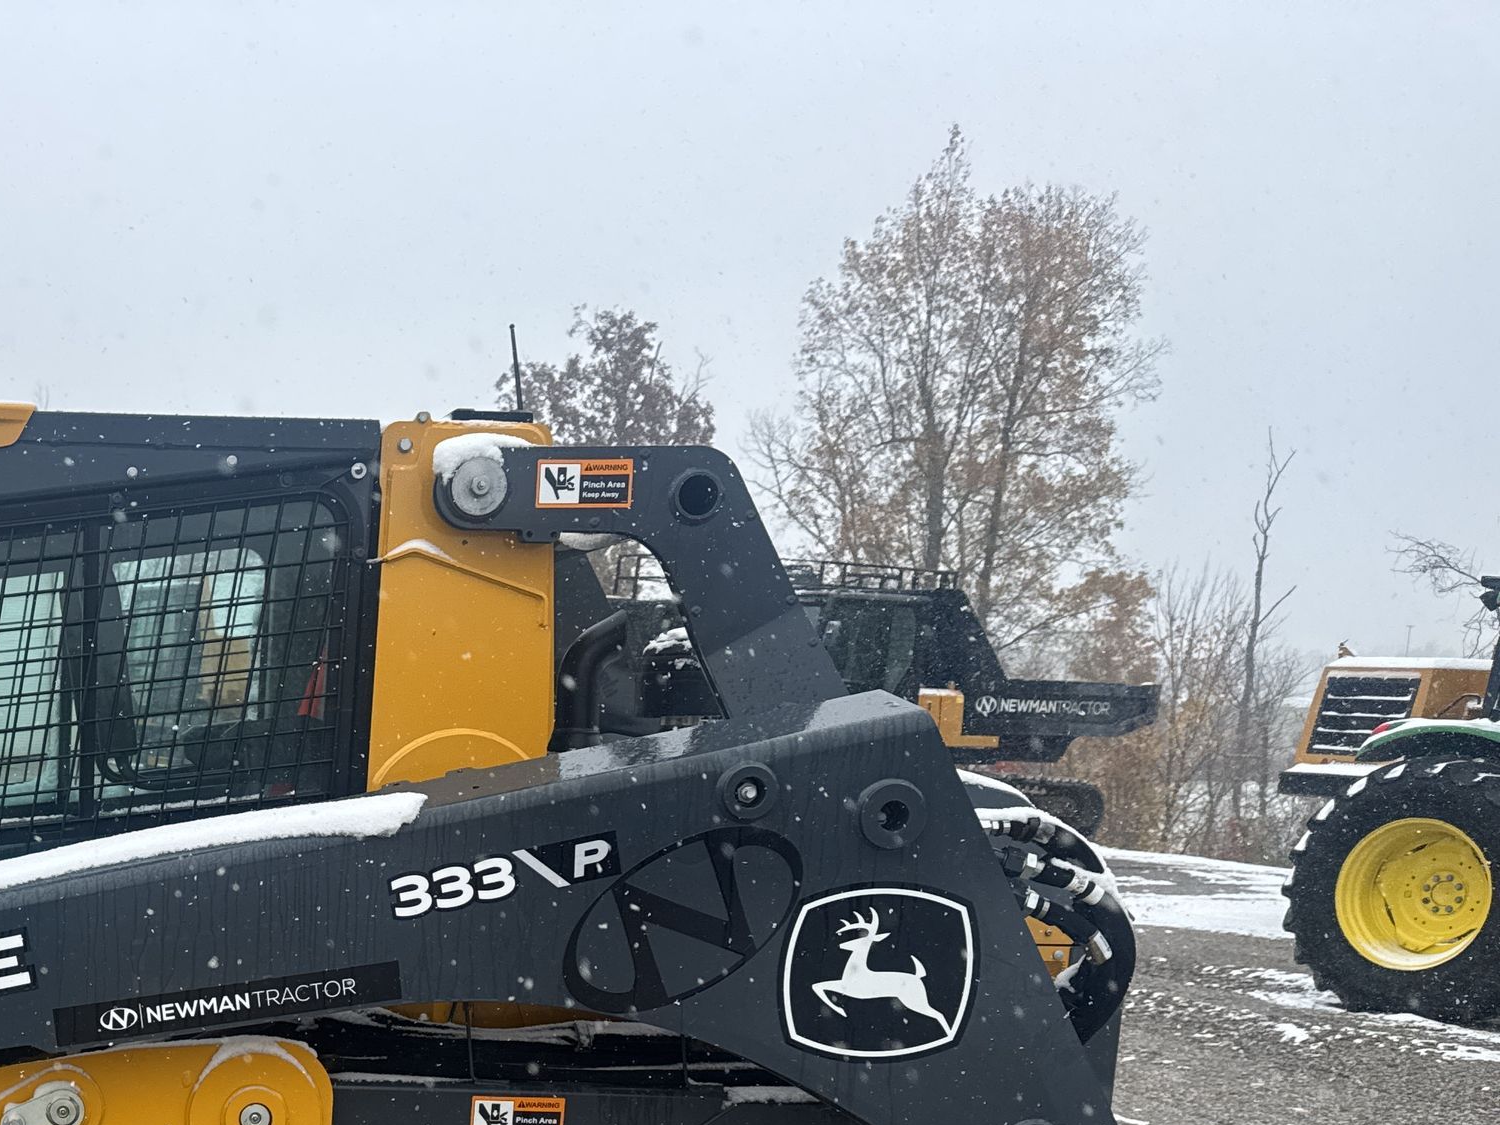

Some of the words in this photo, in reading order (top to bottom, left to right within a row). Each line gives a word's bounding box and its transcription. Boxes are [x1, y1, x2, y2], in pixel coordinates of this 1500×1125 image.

[591, 463, 629, 472] WARNING
[583, 480, 605, 489] Pinch
[606, 480, 626, 489] Area
[582, 491, 599, 499] Keep
[601, 491, 620, 499] Away
[524, 1101, 561, 1109] WARNING
[515, 1116, 538, 1124] Pinch
[538, 1116, 558, 1125] Area
